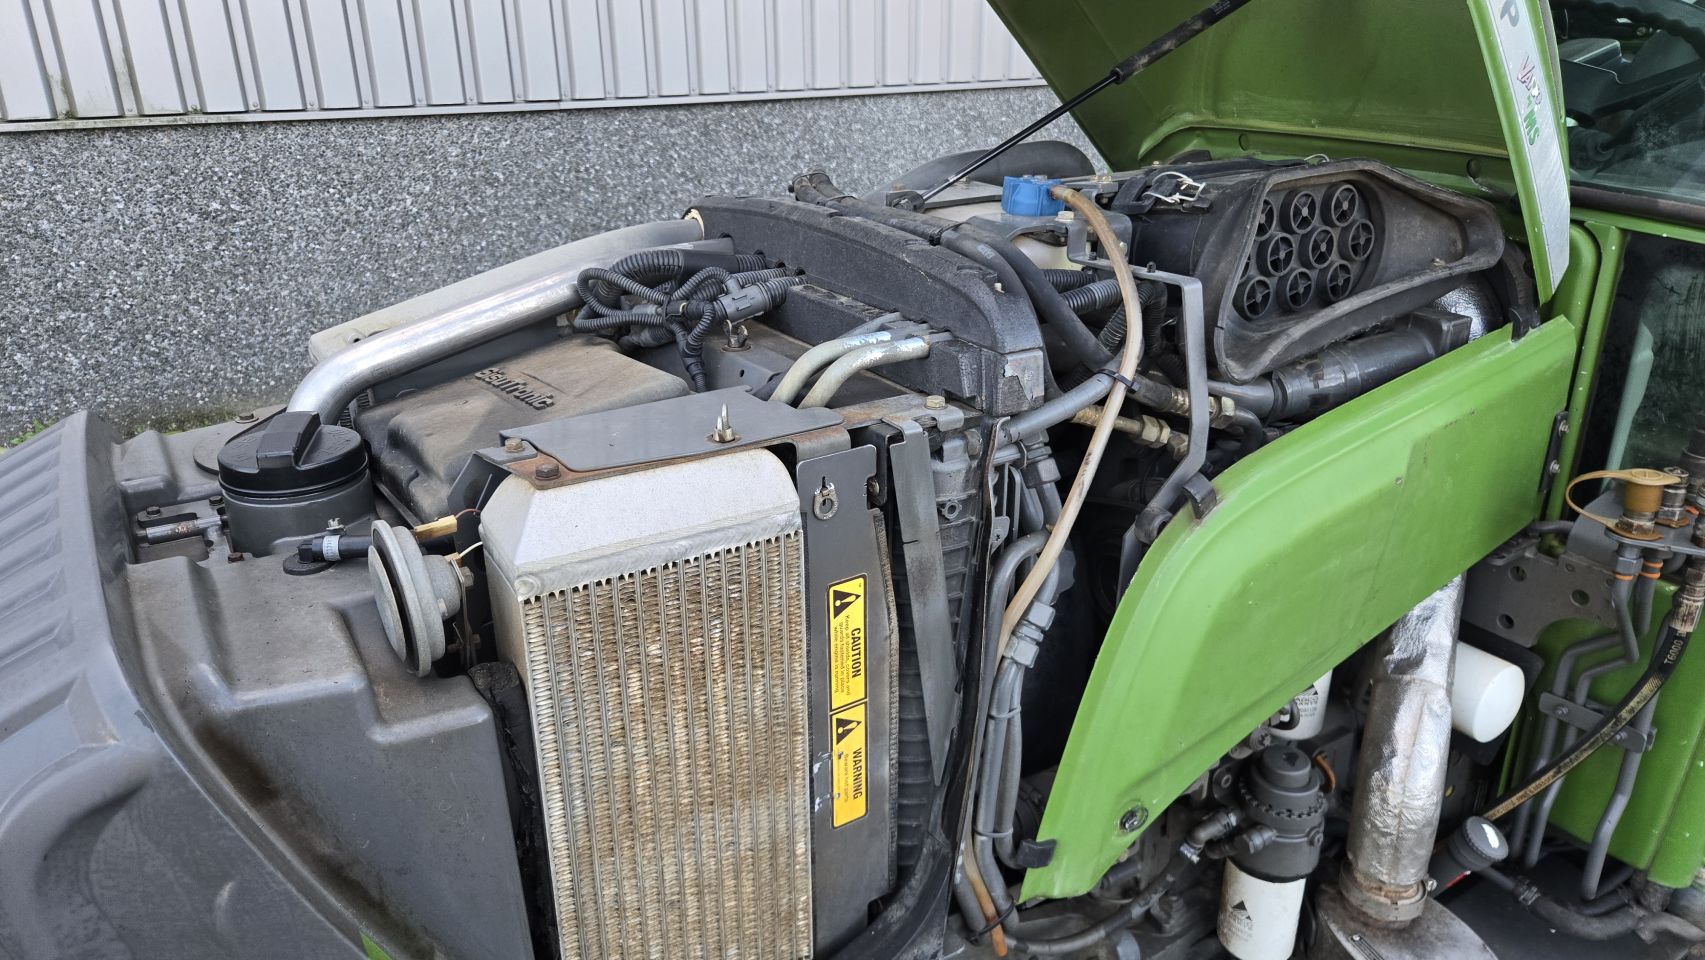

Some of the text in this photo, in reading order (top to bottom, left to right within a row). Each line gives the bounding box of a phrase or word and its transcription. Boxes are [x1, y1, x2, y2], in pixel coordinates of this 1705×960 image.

[851, 627, 861, 678] CAUTION
[1664, 639, 1684, 664] T6000
[852, 747, 862, 800] WARNING
